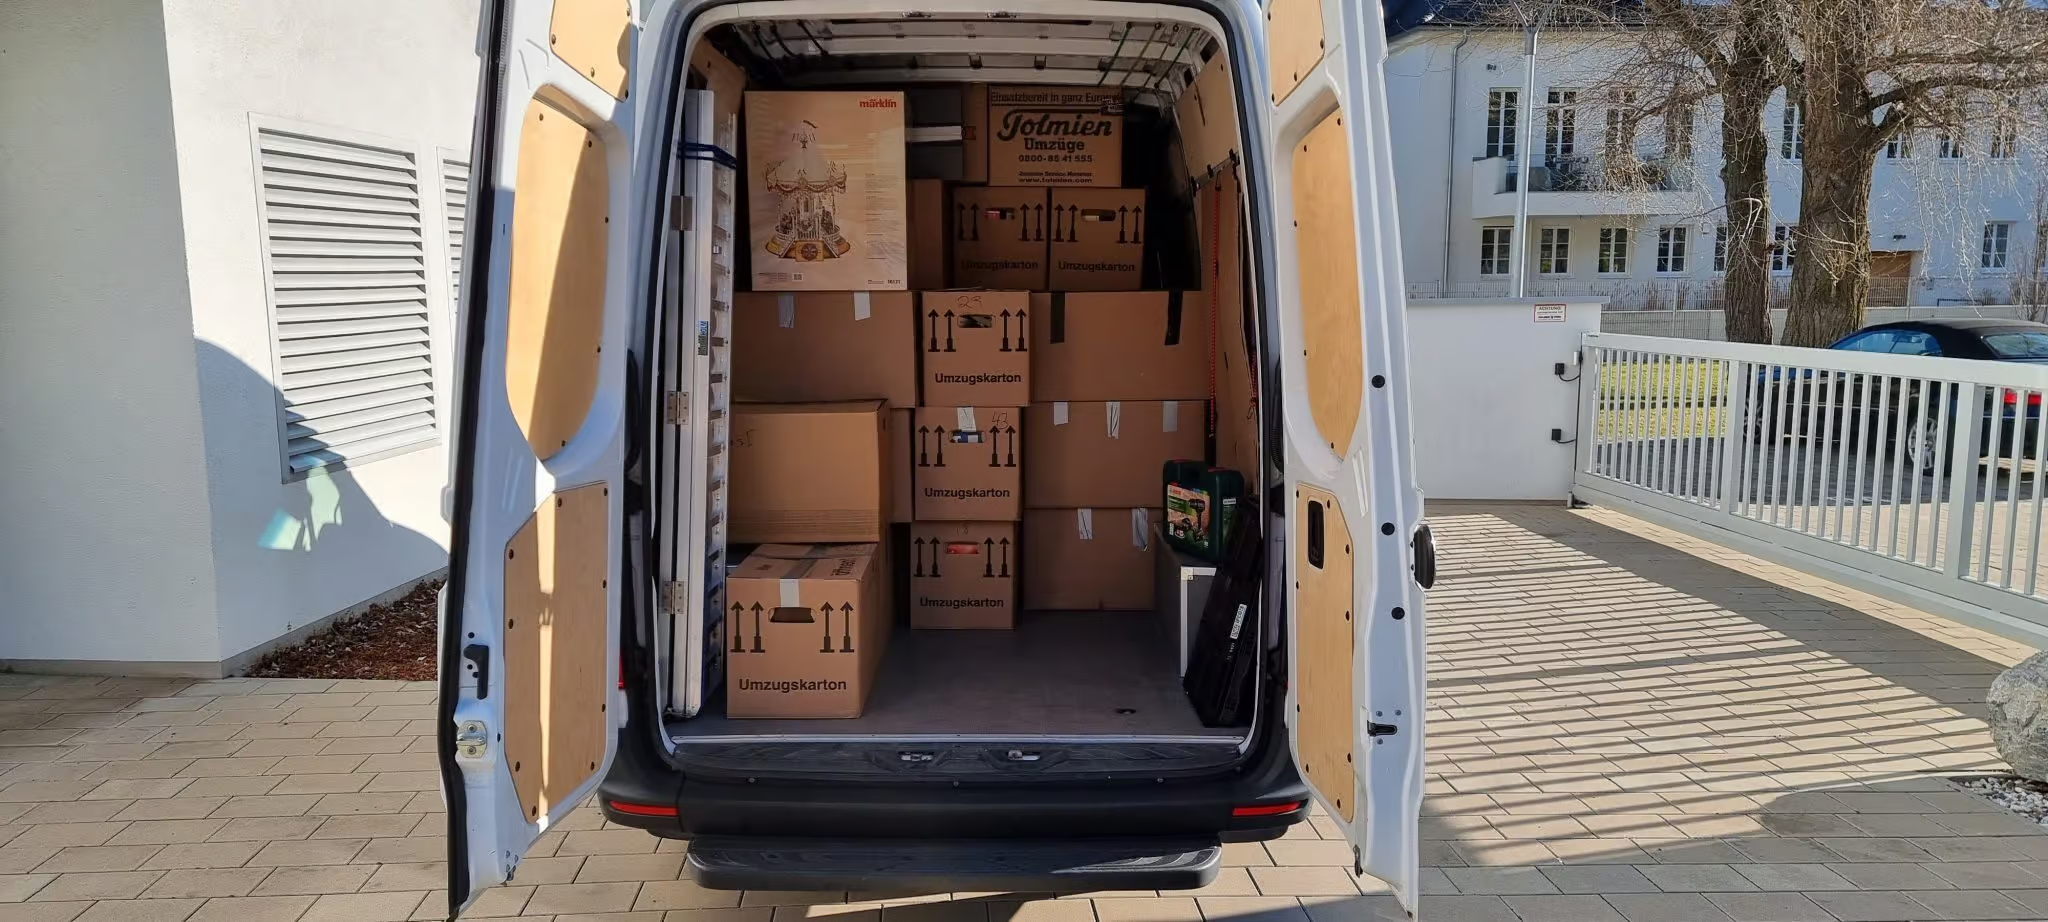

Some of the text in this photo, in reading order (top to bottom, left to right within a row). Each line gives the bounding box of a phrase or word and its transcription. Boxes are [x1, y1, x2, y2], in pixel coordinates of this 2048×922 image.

[859, 98, 897, 108] märklin
[1050, 91, 1059, 102] in
[1061, 94, 1083, 104] ganz
[997, 108, 1112, 141] Tolmien
[1024, 137, 1085, 153] Umzüge
[961, 259, 1039, 272] Umzugskarton
[1058, 260, 1136, 273] Umzugskarton
[935, 373, 1022, 385] Umzugskarton
[924, 487, 1010, 499] Umzugskarton
[920, 596, 1004, 609] Umzugskarton
[738, 679, 847, 694] Umzugskarton
